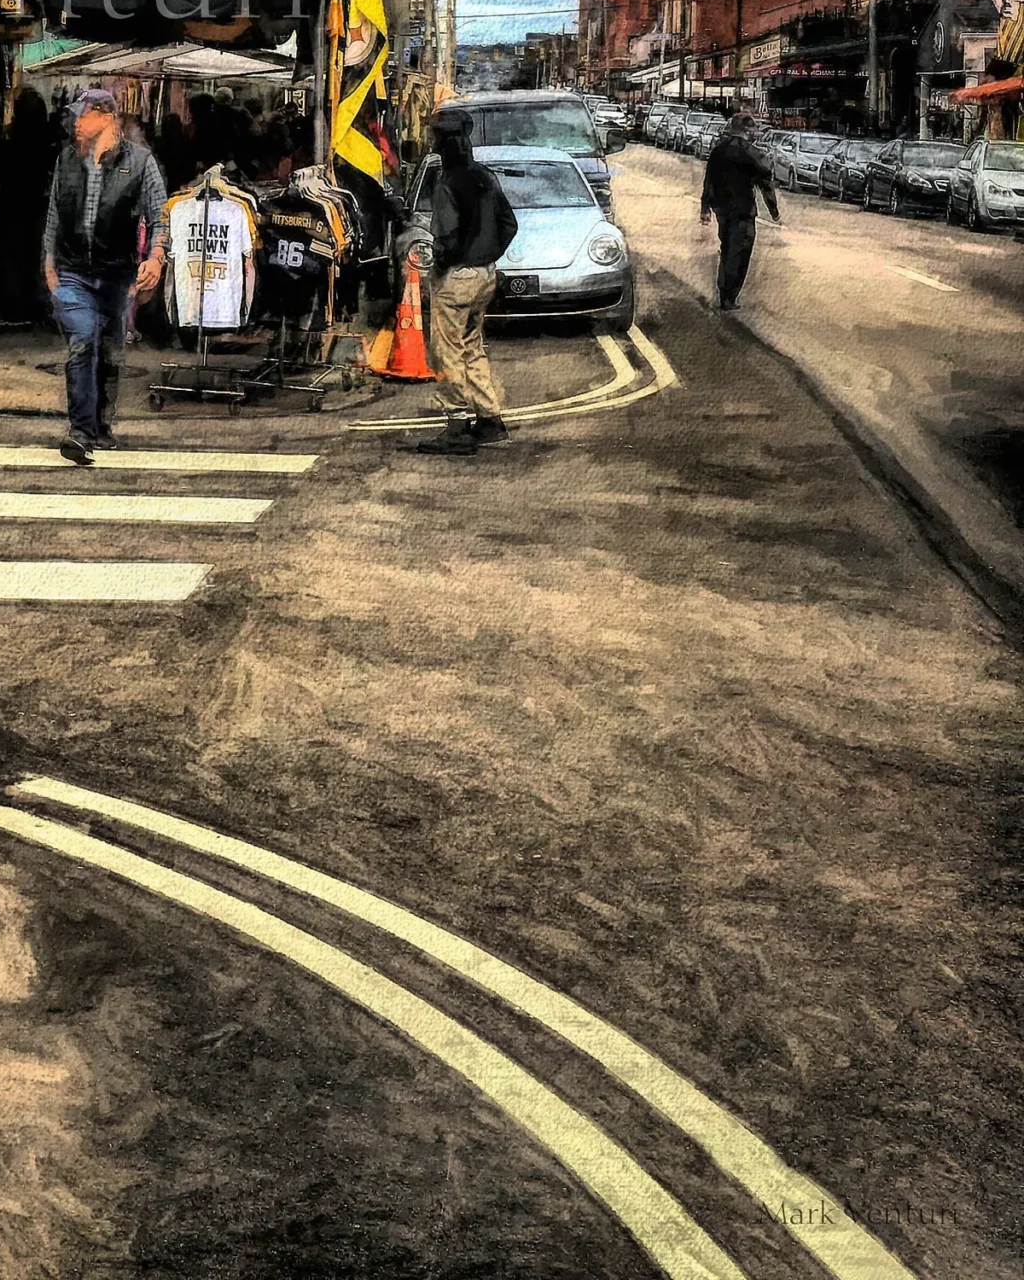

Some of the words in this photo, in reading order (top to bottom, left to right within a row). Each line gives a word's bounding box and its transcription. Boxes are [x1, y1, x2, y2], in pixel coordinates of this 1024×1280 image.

[272, 214, 311, 228] PITTSBURGH
[188, 223, 230, 239] TURN
[187, 238, 229, 254] DOWN
[277, 239, 305, 267] 86
